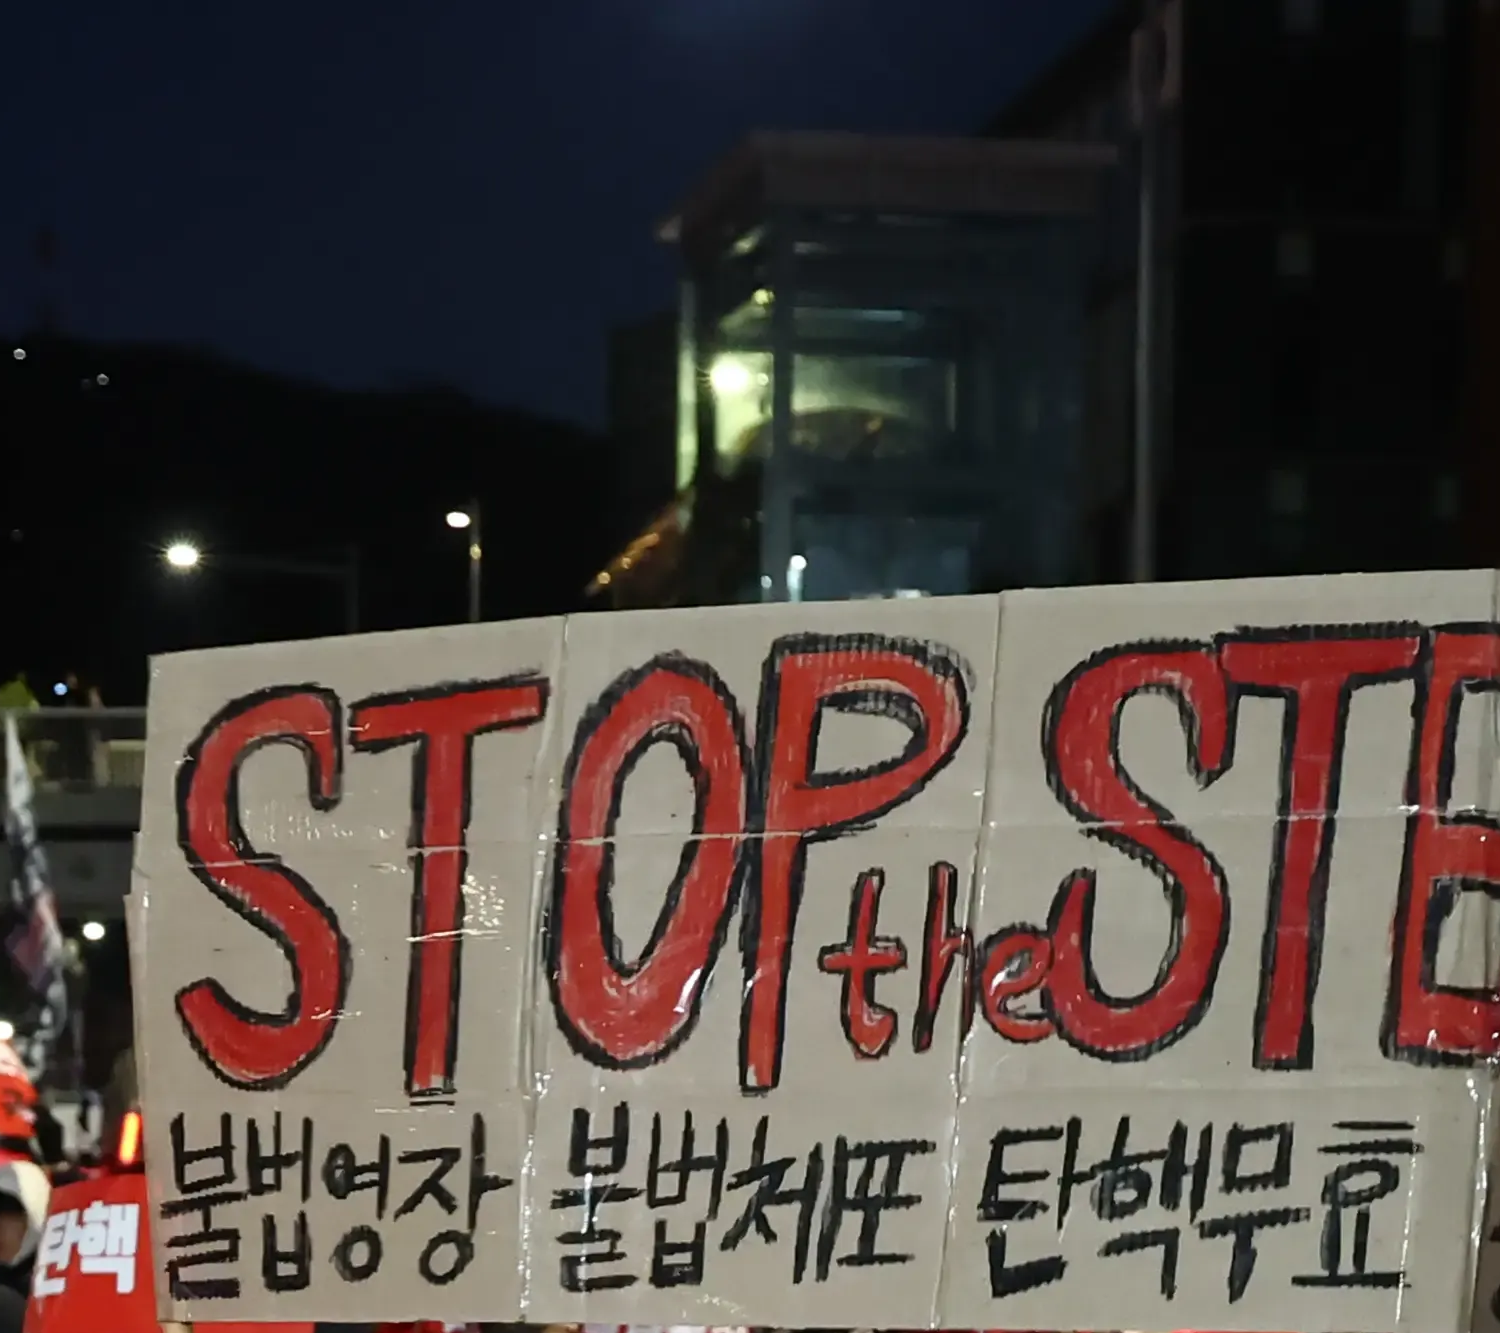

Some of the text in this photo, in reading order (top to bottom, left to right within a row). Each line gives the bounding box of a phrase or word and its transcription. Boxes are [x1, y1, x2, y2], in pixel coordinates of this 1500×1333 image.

[174, 632, 974, 1097] STOP
[816, 860, 1055, 1061] the
[32, 1199, 140, 1297] 탄핵
[158, 1108, 509, 1299] 불법영장
[552, 1103, 936, 1293] 불법체포
[980, 1112, 1420, 1299] 탄핵무효
